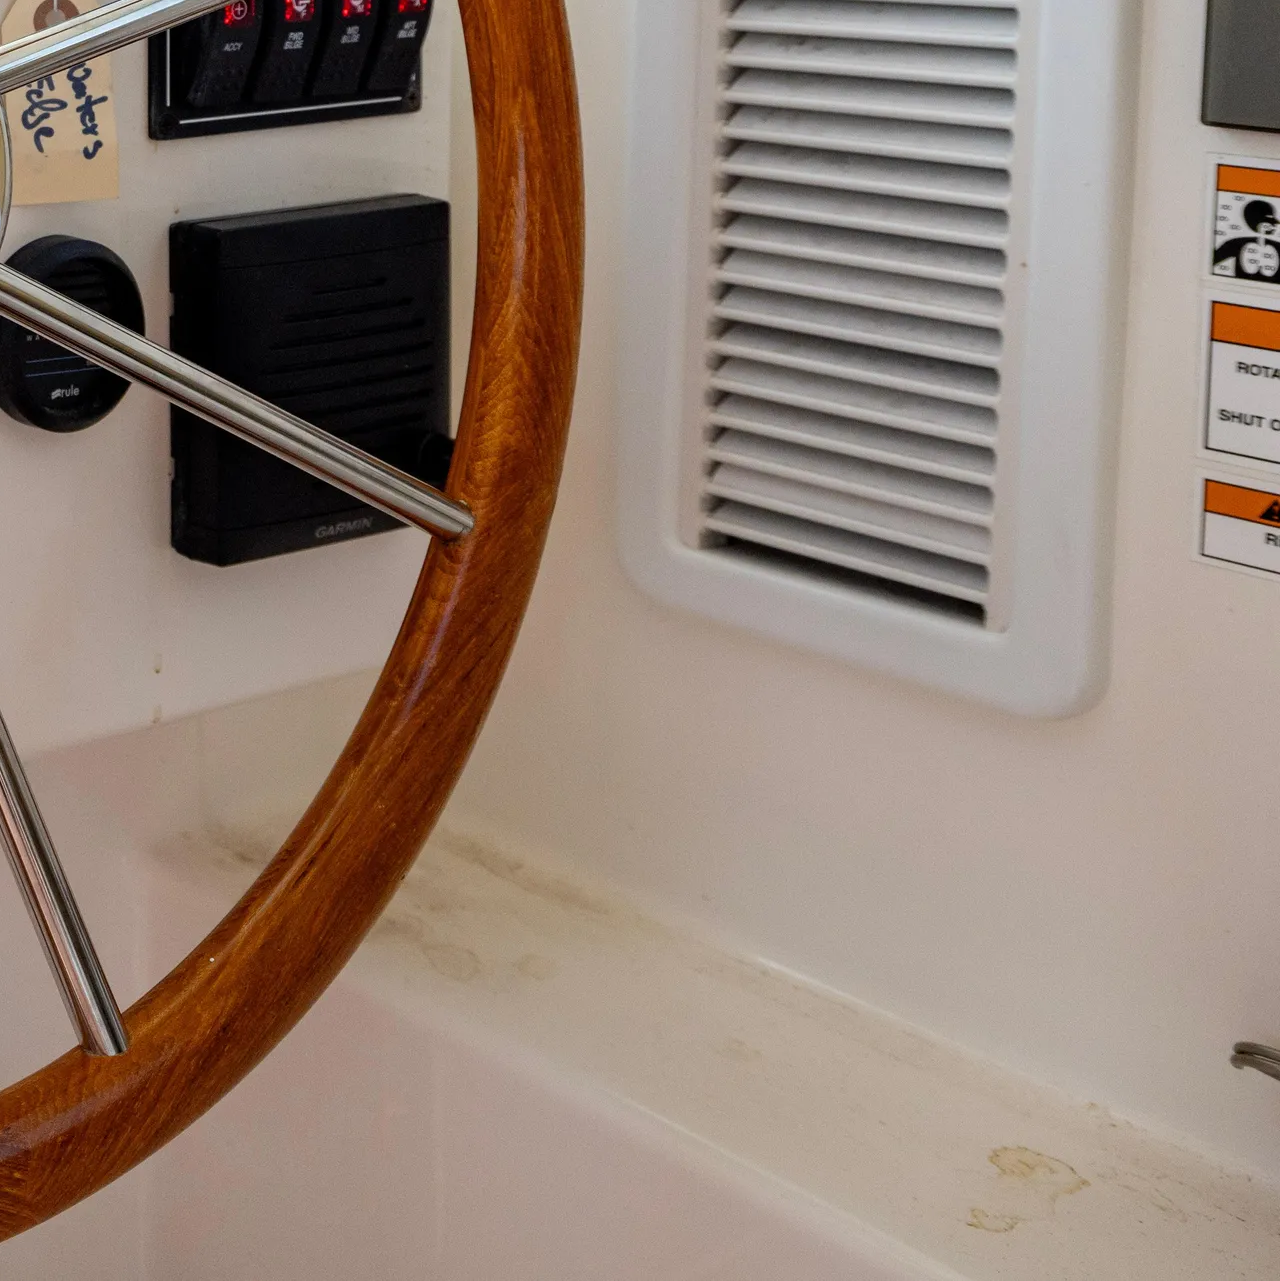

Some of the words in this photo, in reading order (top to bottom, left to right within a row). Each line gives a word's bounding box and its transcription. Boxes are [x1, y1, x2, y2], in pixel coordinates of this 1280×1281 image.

[223, 42, 244, 52] ACCY
[66, 62, 108, 160] aters
[1235, 361, 1280, 380] ROTA
[61, 384, 80, 398] rule
[1218, 408, 1267, 428] SHUT
